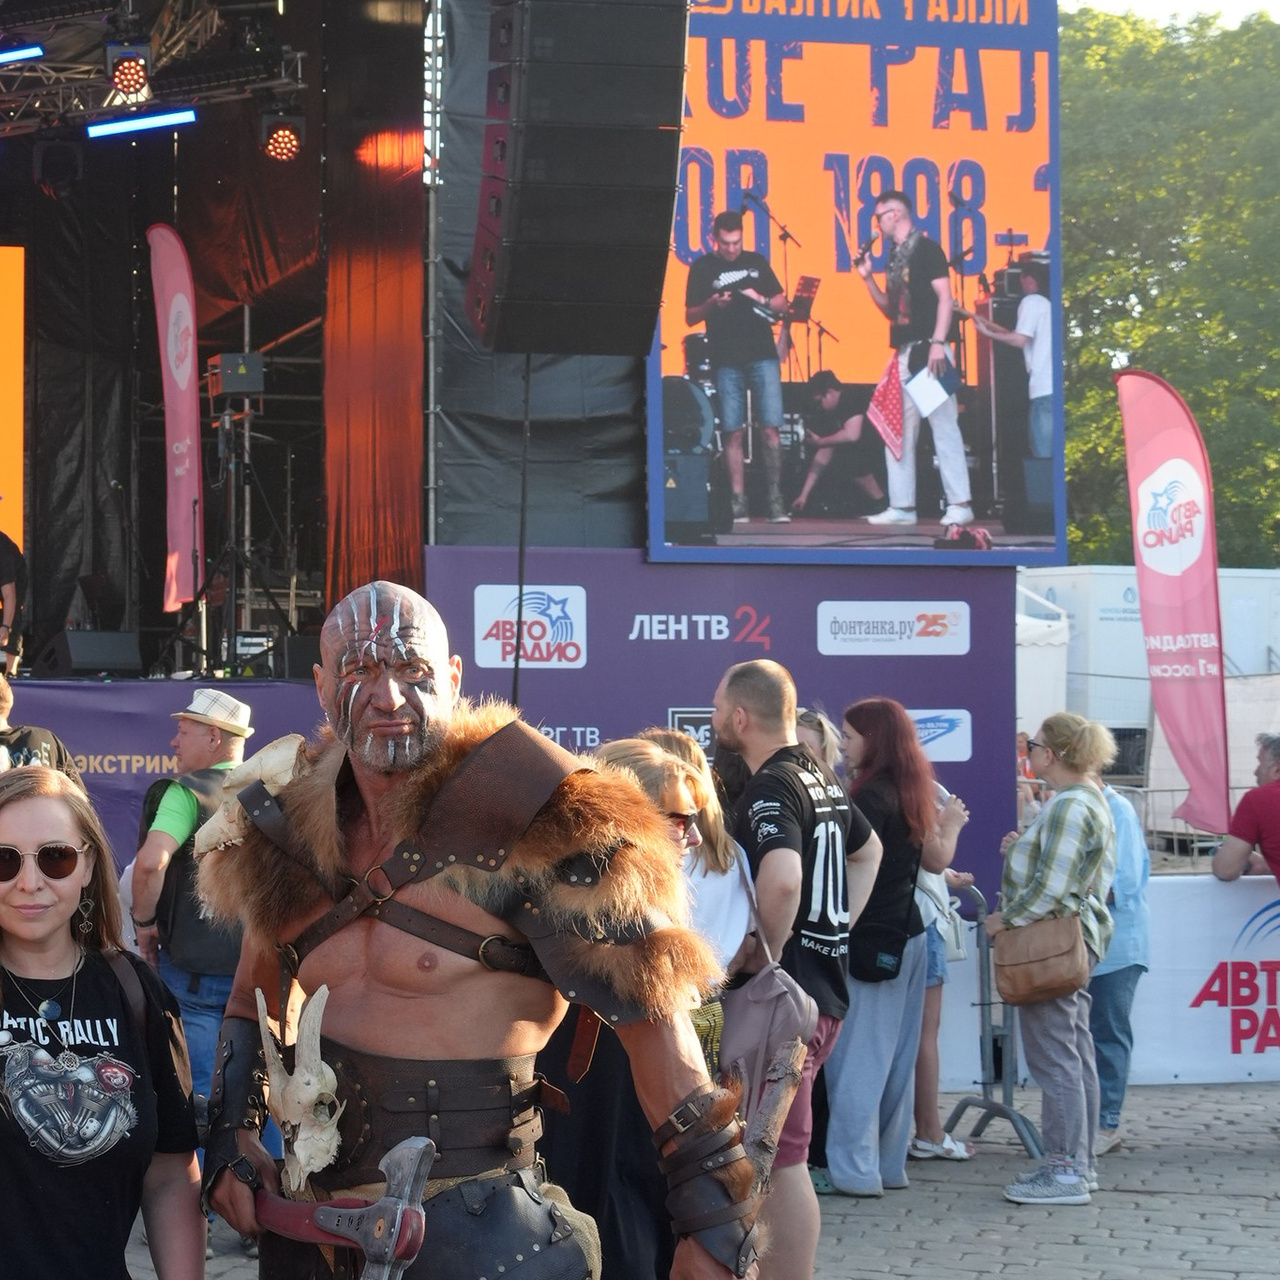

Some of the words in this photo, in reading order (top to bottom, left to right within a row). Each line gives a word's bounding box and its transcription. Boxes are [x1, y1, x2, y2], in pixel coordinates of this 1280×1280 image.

[482, 619, 548, 641] АВТО
[628, 614, 689, 641] ЛЕН
[691, 614, 731, 641] ТВ
[732, 603, 771, 651] 24
[829, 615, 916, 641] фонтанка.ру
[916, 613, 950, 638] 25
[501, 641, 582, 663] РАДИО
[571, 726, 601, 748] ТВ
[72, 753, 180, 775] ЭКСТРИМ
[800, 936, 831, 957] MAKE
[56, 1018, 120, 1047] RALLY
